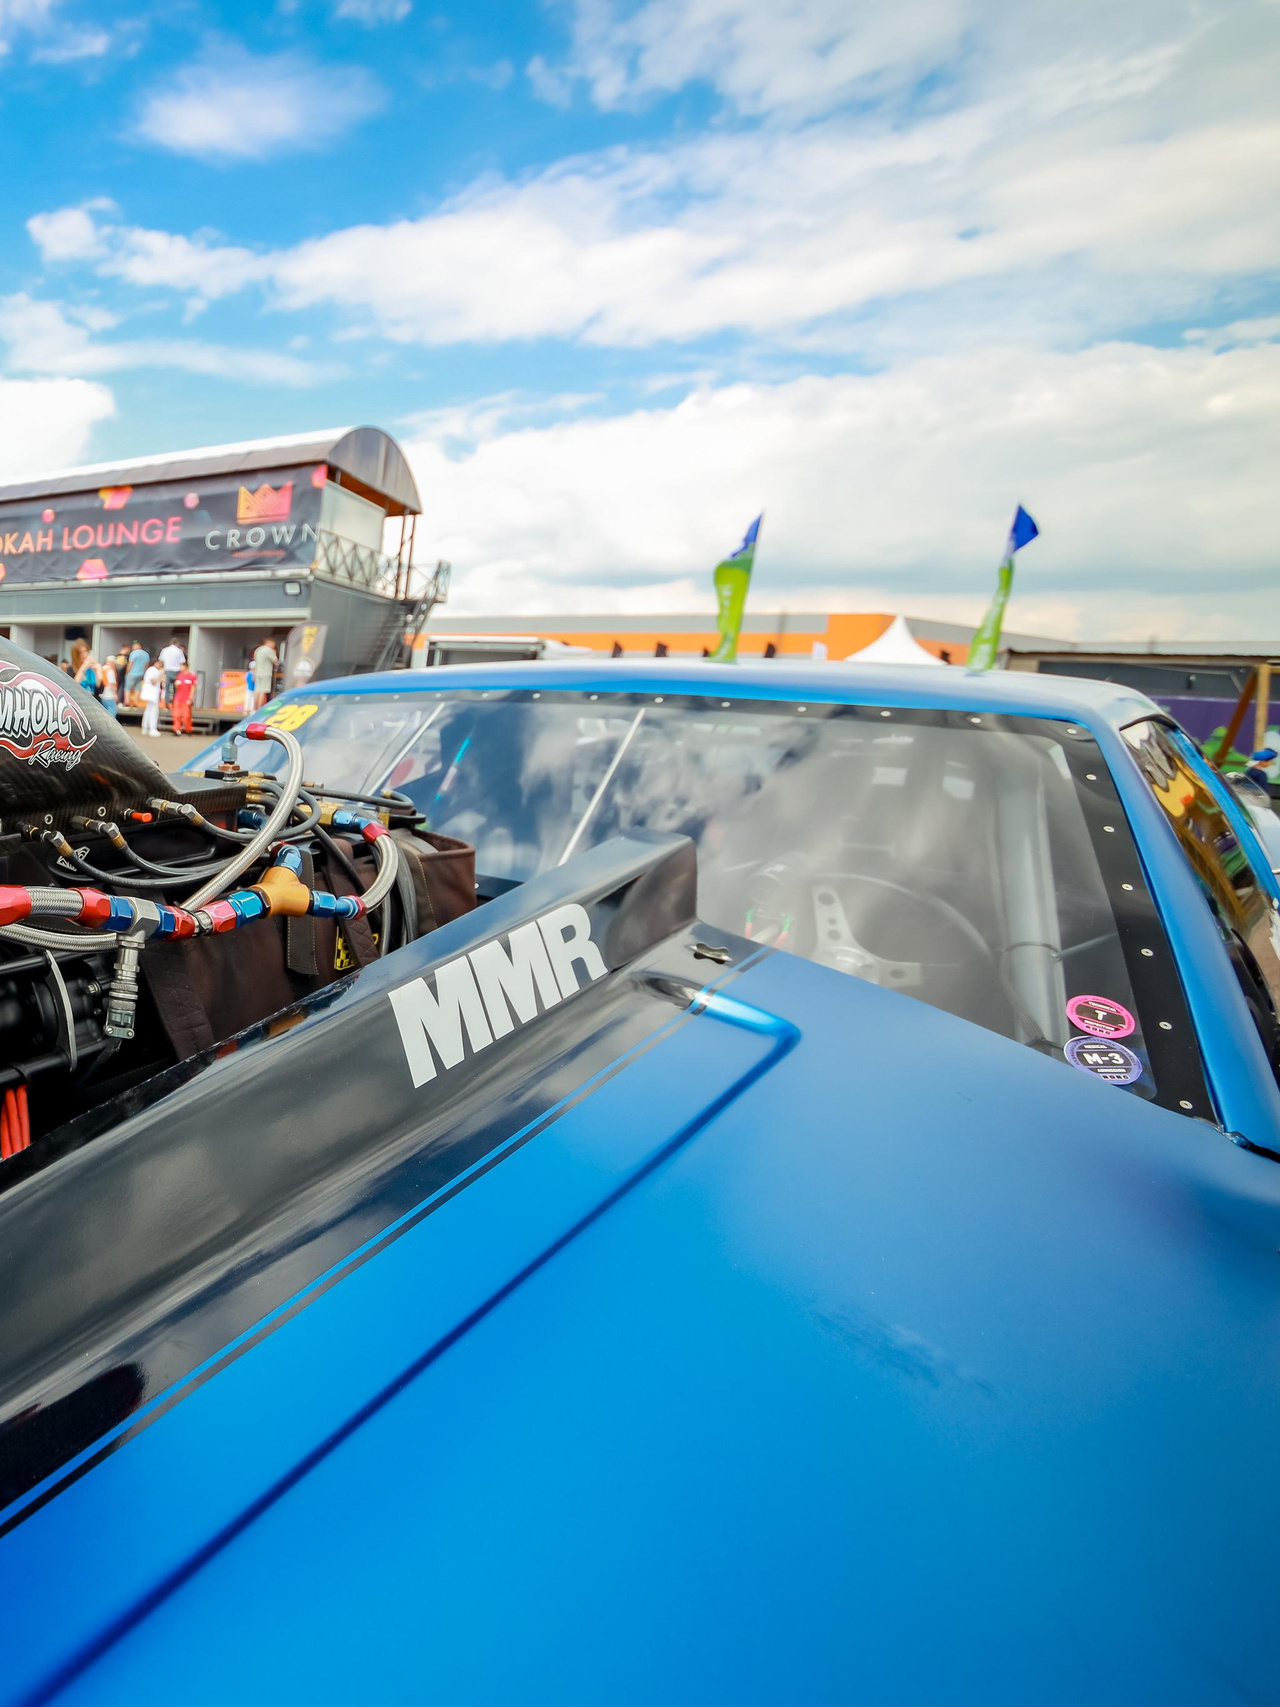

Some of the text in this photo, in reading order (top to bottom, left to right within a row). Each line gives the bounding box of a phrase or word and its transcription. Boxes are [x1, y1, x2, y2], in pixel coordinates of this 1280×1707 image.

[62, 516, 182, 550] LOUNGE
[205, 523, 319, 550] CROWN
[264, 704, 318, 731] 28
[28, 739, 82, 771] Racing
[388, 903, 608, 1089] MMR
[1095, 1010, 1107, 1020] T
[1083, 1052, 1124, 1065] M-3
